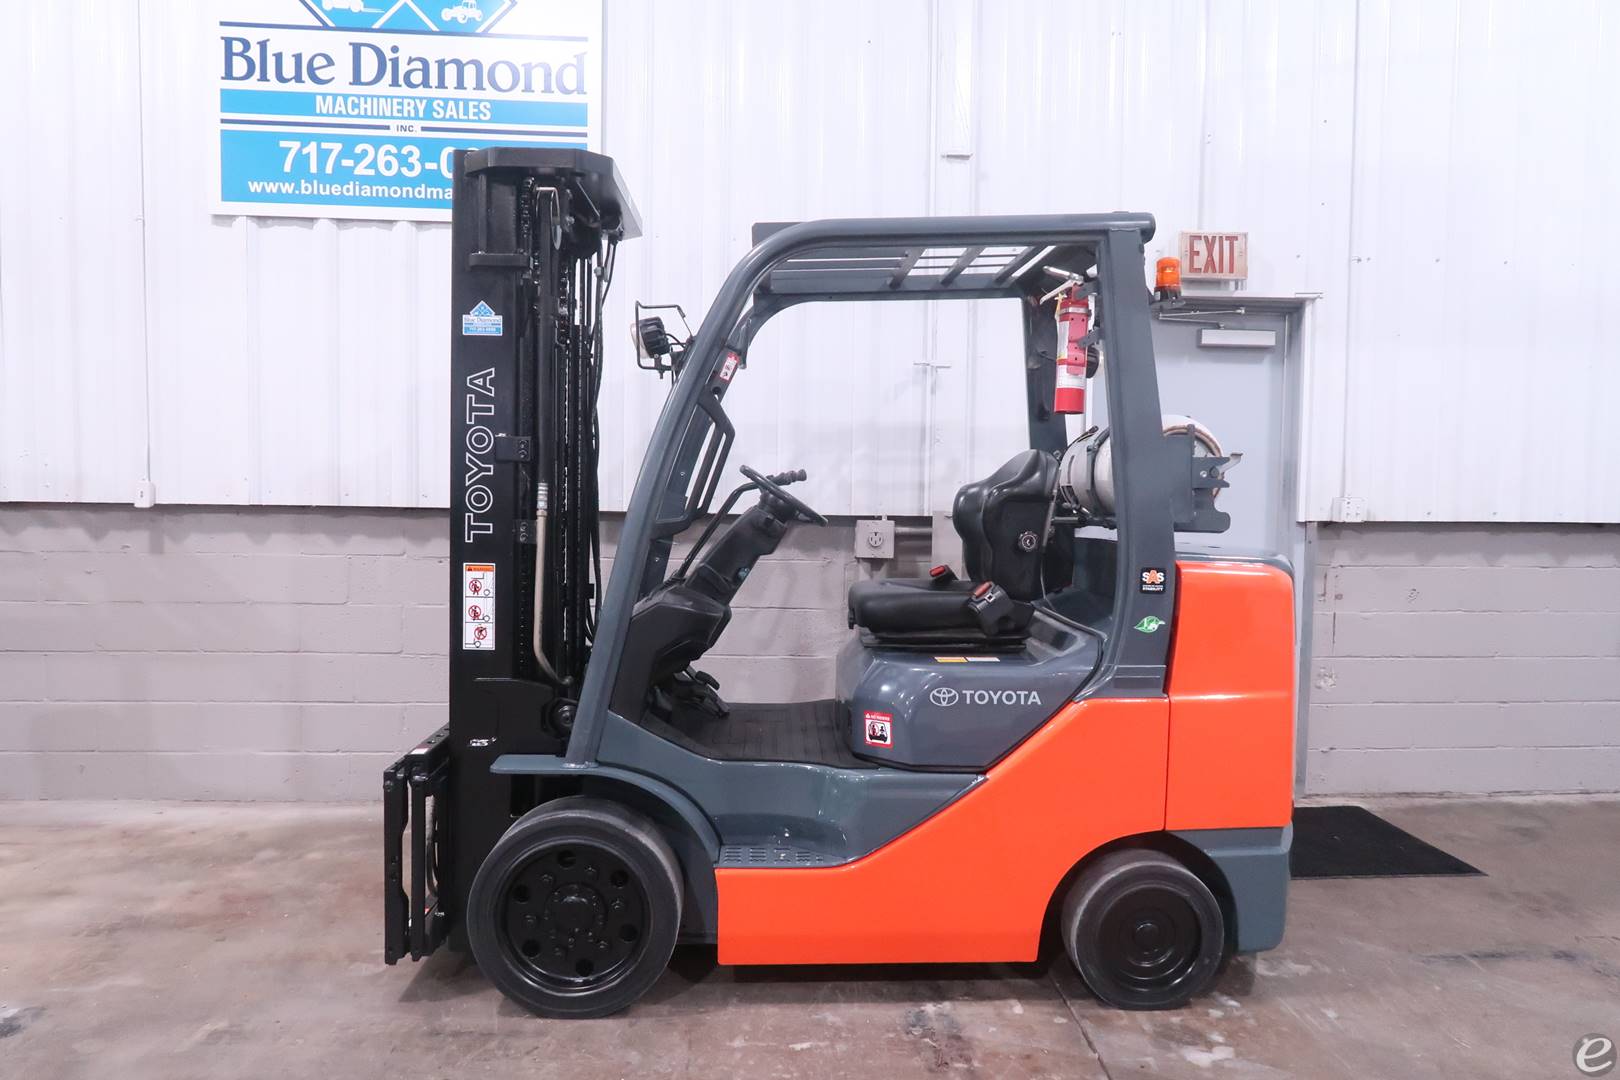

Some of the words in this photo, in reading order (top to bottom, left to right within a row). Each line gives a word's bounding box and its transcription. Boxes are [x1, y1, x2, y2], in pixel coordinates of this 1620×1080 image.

[220, 36, 335, 86] Blue
[349, 42, 587, 95] Diamond
[315, 95, 428, 119] MACHINERY
[432, 99, 491, 121] SALES
[396, 124, 418, 133] INC.
[278, 140, 479, 179] 717-263-0
[1188, 235, 1238, 274] EXIT
[465, 367, 495, 543] TOYOTA
[1142, 569, 1165, 584] SAS
[962, 690, 1042, 705] TOYOTA
